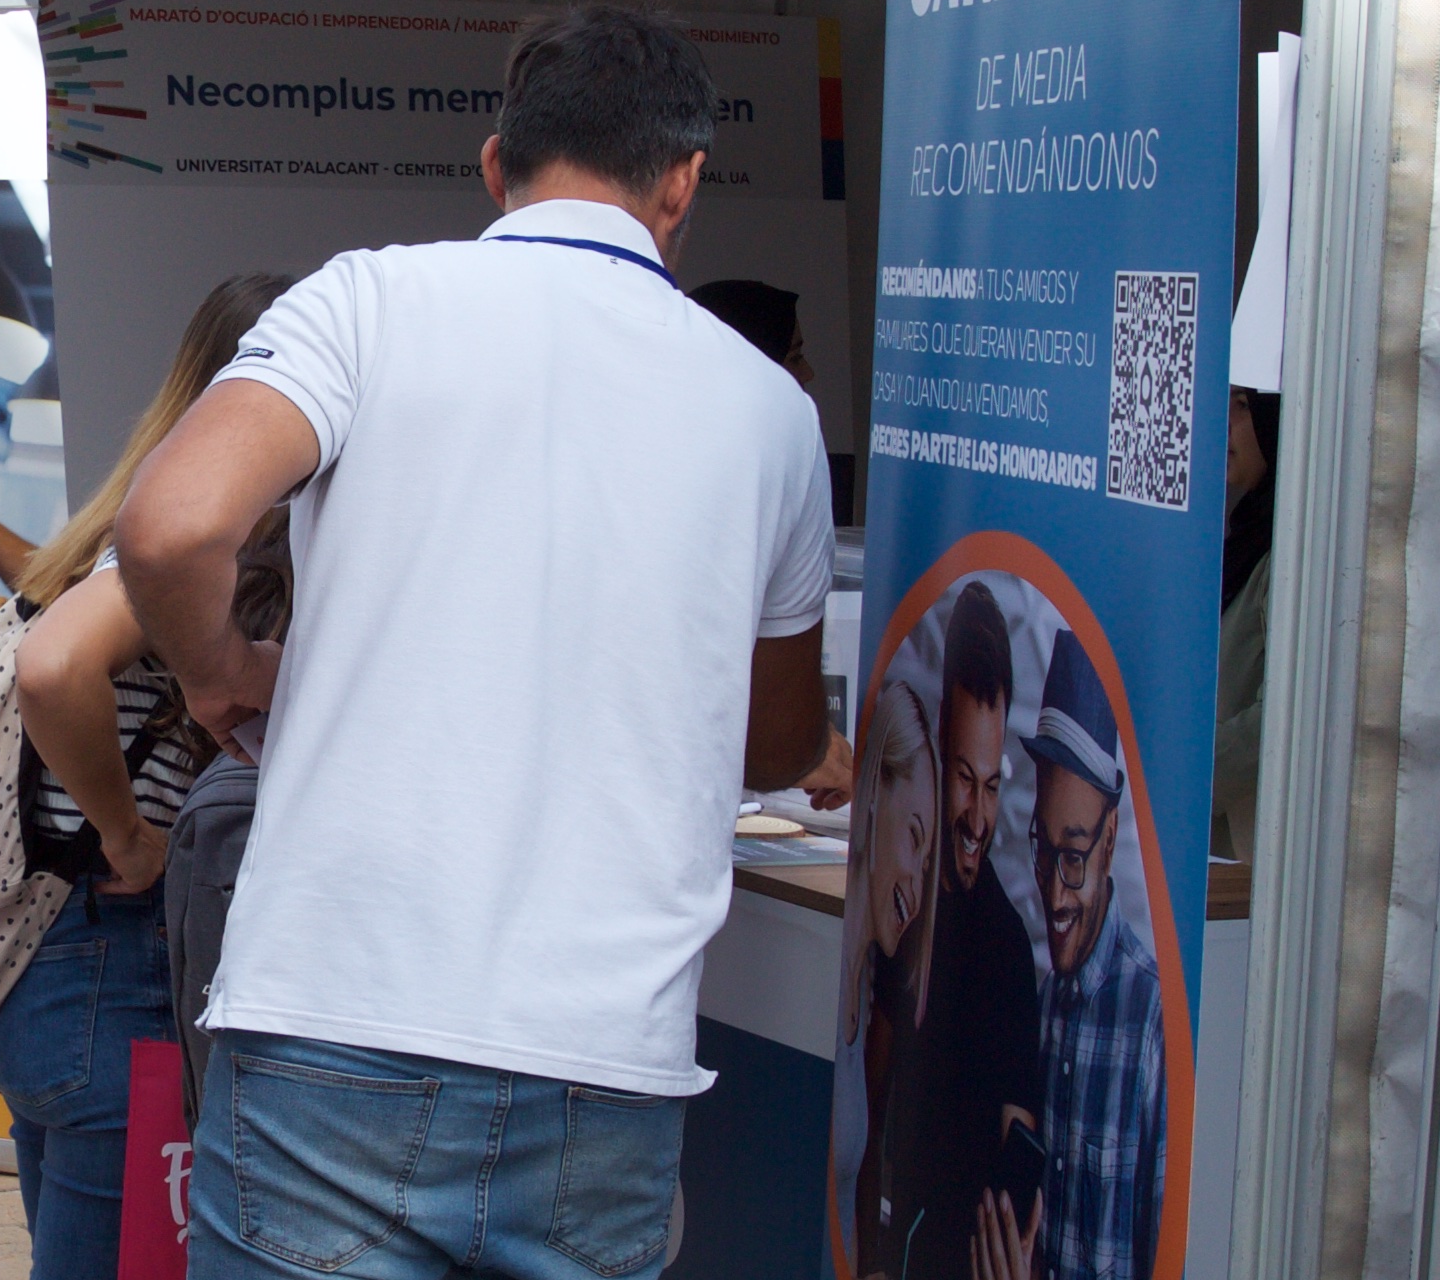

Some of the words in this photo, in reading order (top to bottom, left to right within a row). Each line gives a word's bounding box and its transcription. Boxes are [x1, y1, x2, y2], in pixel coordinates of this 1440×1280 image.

[130, 7, 202, 24] MARATÓ
[322, 14, 450, 32] EMPRENEDORIA
[690, 29, 780, 46] ENDIMIENTO
[166, 74, 396, 116] Necomplus
[976, 54, 1006, 111] DE
[1011, 44, 1086, 108] MEDIA
[176, 158, 284, 174] UNIVERSITAT
[394, 162, 455, 177] CENTRE
[730, 172, 750, 184] UA
[910, 125, 1160, 197] RECOMENDÁNDONOS
[882, 259, 976, 300] RECOMÉNDANOS
[976, 270, 985, 300] A
[987, 269, 1014, 302] TUS
[1015, 270, 1067, 304] AMIGOS
[1070, 271, 1079, 304] Y
[932, 322, 962, 355] QUE
[963, 324, 1016, 360] QUIERAN
[1018, 328, 1072, 365] VENDER
[1074, 332, 1096, 368] SU
[873, 371, 895, 402] CASA
[896, 374, 904, 403] Y
[904, 375, 959, 410] CUANDO
[961, 381, 973, 412] LA
[974, 383, 1050, 428] VENDAMOS,
[910, 430, 956, 466] PARTE
[957, 435, 971, 469] DE
[972, 439, 999, 473] LOS
[999, 443, 1098, 492] HONORARIOS!
